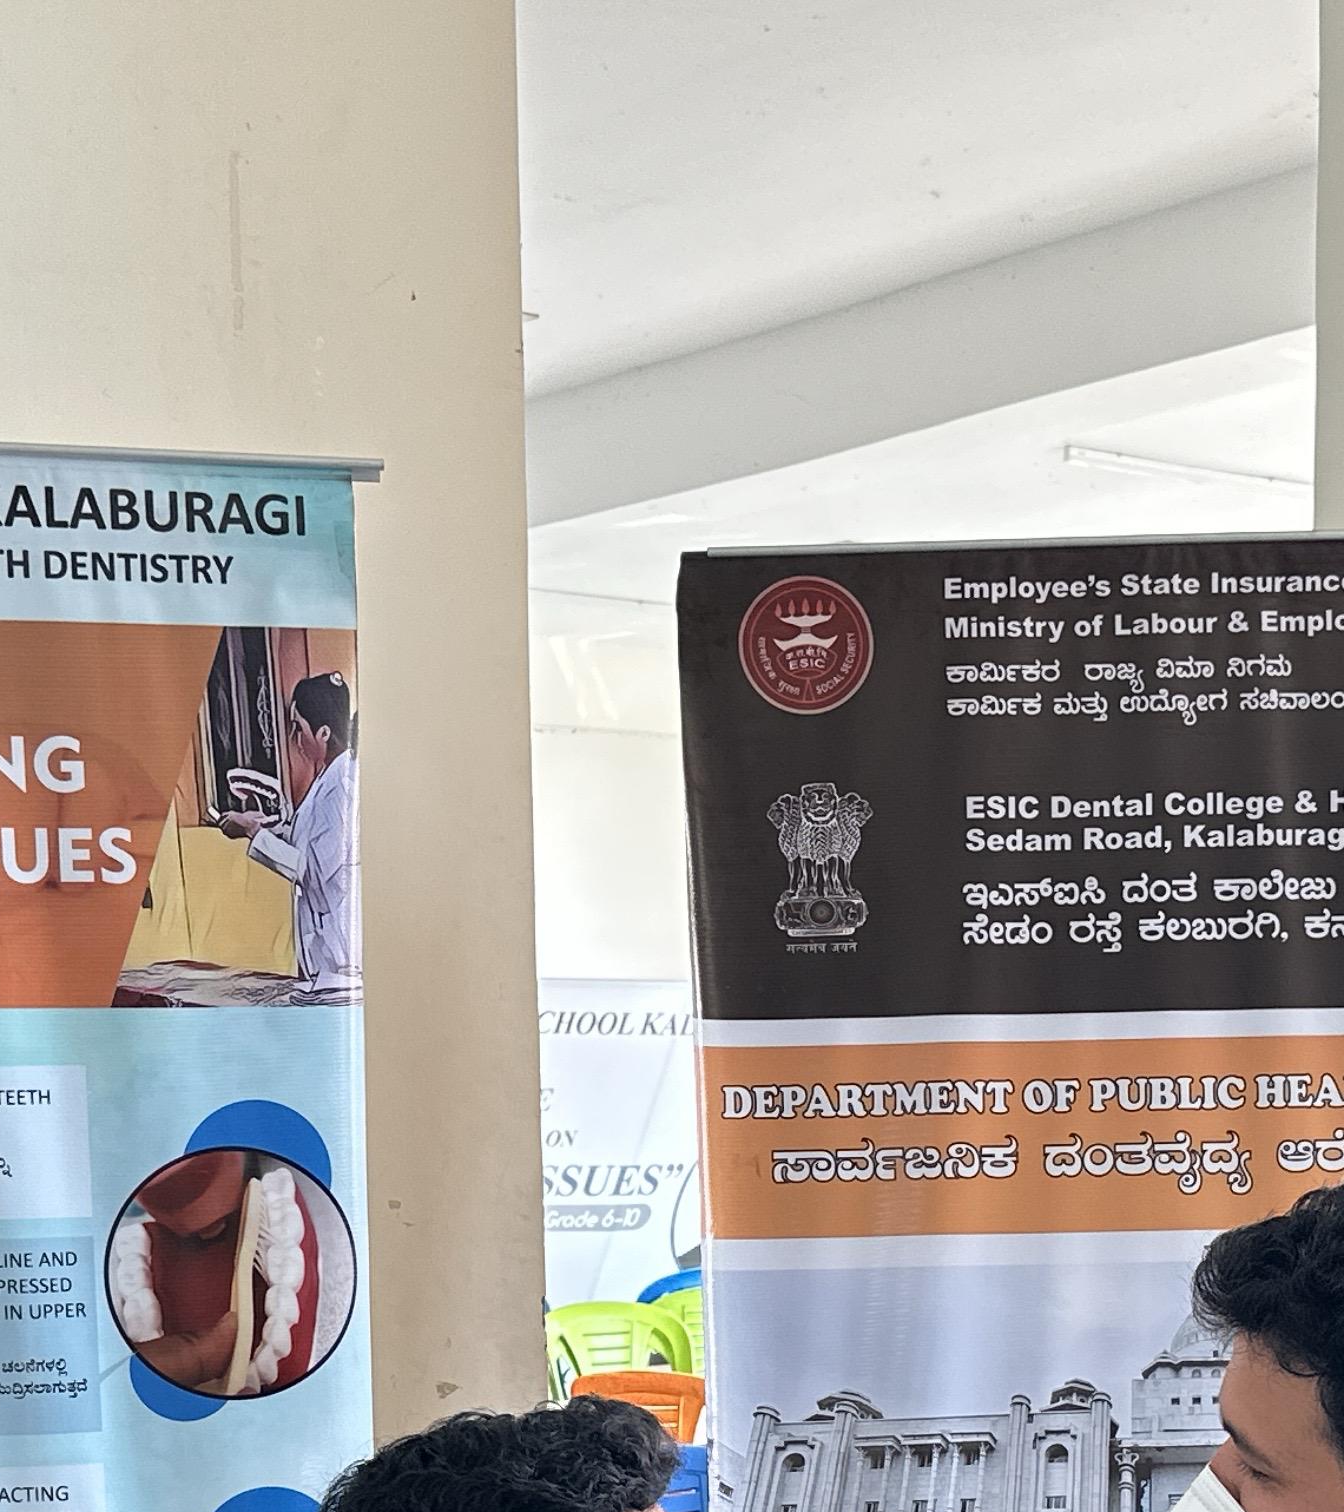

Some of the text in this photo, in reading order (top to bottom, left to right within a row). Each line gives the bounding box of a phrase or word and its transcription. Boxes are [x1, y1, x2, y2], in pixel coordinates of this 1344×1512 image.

[43, 549, 234, 586] DENTISTRY
[1120, 572, 1201, 597] State
[944, 615, 1065, 644] Ministry
[1073, 613, 1104, 638] of
[1114, 612, 1218, 636] Labour
[1227, 609, 1250, 634] &
[788, 658, 826, 671] ESIC
[1226, 652, 1292, 679] ನಿಗಮ
[966, 795, 1040, 821] ESIC
[1050, 792, 1153, 819] Dental
[1164, 791, 1284, 821] College
[1294, 789, 1318, 814] &
[965, 827, 1072, 853] Sedam
[1083, 824, 1172, 855] Road,
[722, 1074, 1014, 1125] DEPARTMENT
[1023, 1079, 1080, 1113] OF
[1089, 1072, 1245, 1112] PUBLIC
